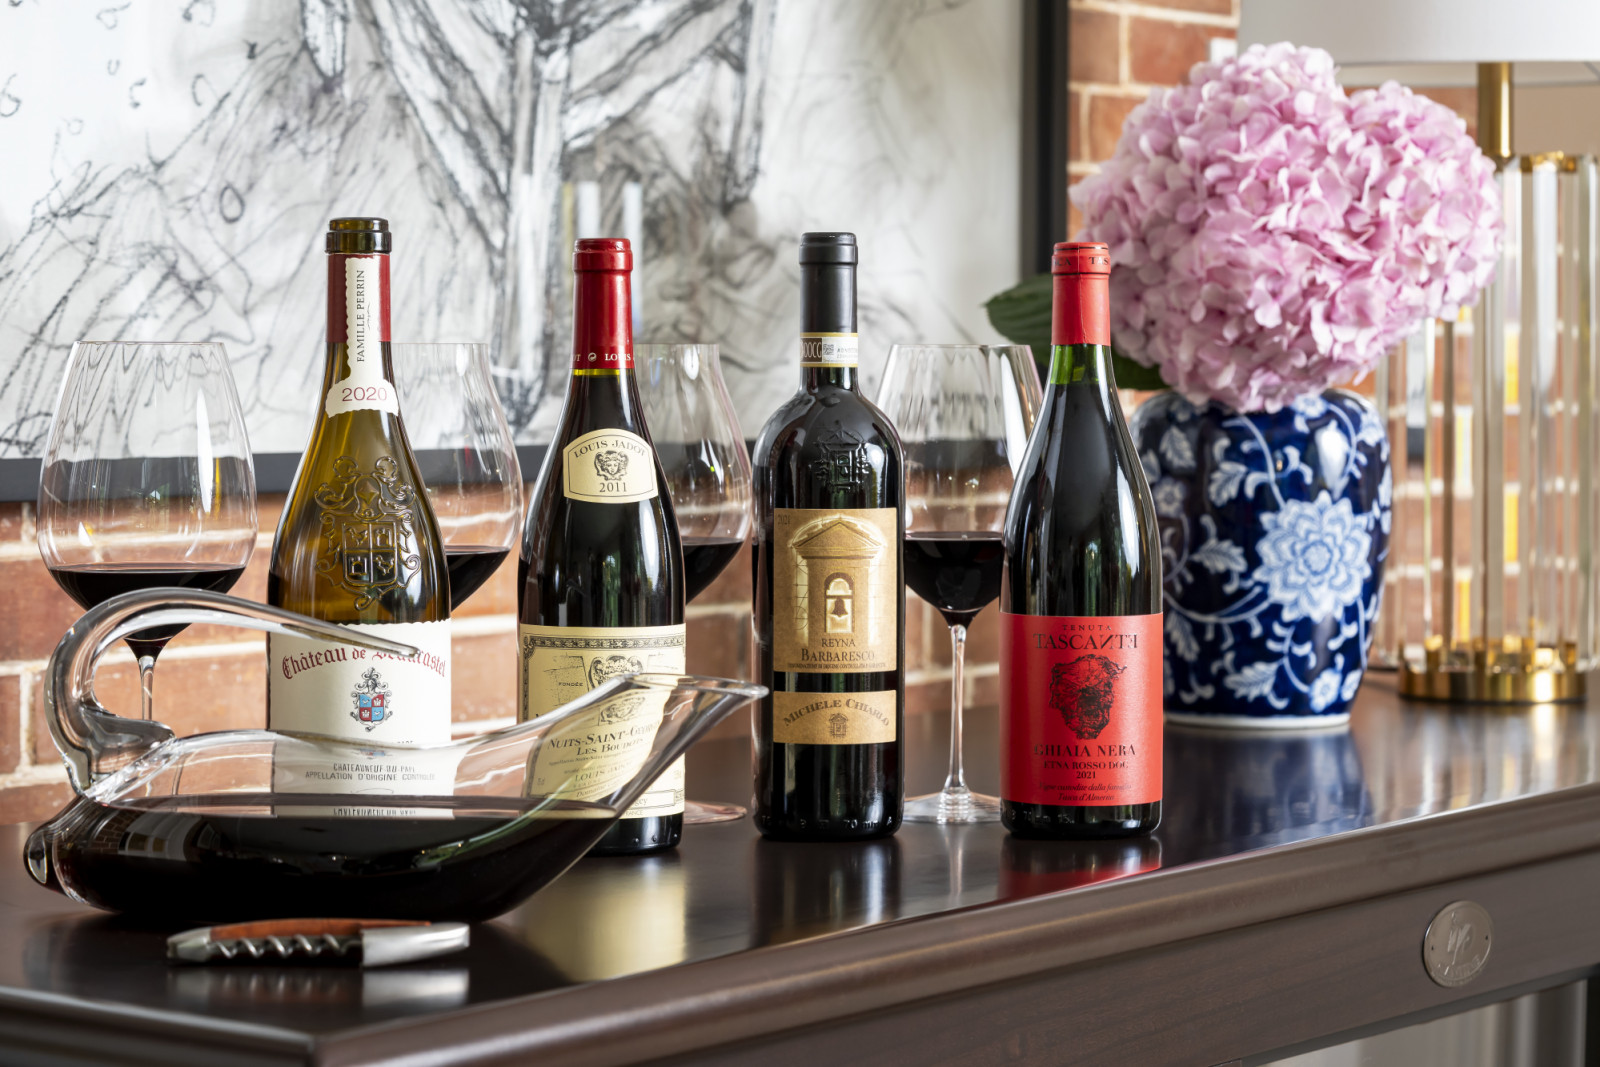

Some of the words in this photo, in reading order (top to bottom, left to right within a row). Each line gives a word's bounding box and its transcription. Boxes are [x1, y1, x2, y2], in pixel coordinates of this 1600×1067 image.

[356, 270, 365, 310] PERRIN
[356, 312, 365, 362] FAMILLE
[604, 353, 632, 361] LOIS
[341, 386, 388, 402] 2020
[574, 440, 608, 458] LOUIS
[612, 439, 645, 457] JADOT
[599, 482, 627, 493] 2011
[821, 638, 856, 648] REYNA
[801, 648, 875, 662] BARBARESCO
[282, 648, 348, 680] Château
[352, 648, 367, 660] de
[783, 699, 842, 727] MICHELE
[845, 698, 890, 727] CHIARLO
[577, 746, 597, 756] LES
[1034, 744, 1091, 757] GHIAIA
[1097, 744, 1136, 757] NERA
[1043, 760, 1070, 769] ETNA
[1072, 761, 1107, 770] ROSSO
[1108, 761, 1129, 770] DOC
[305, 771, 353, 781] APPELLATION
[1076, 771, 1096, 779] 2021
[1088, 783, 1107, 791] dalla
